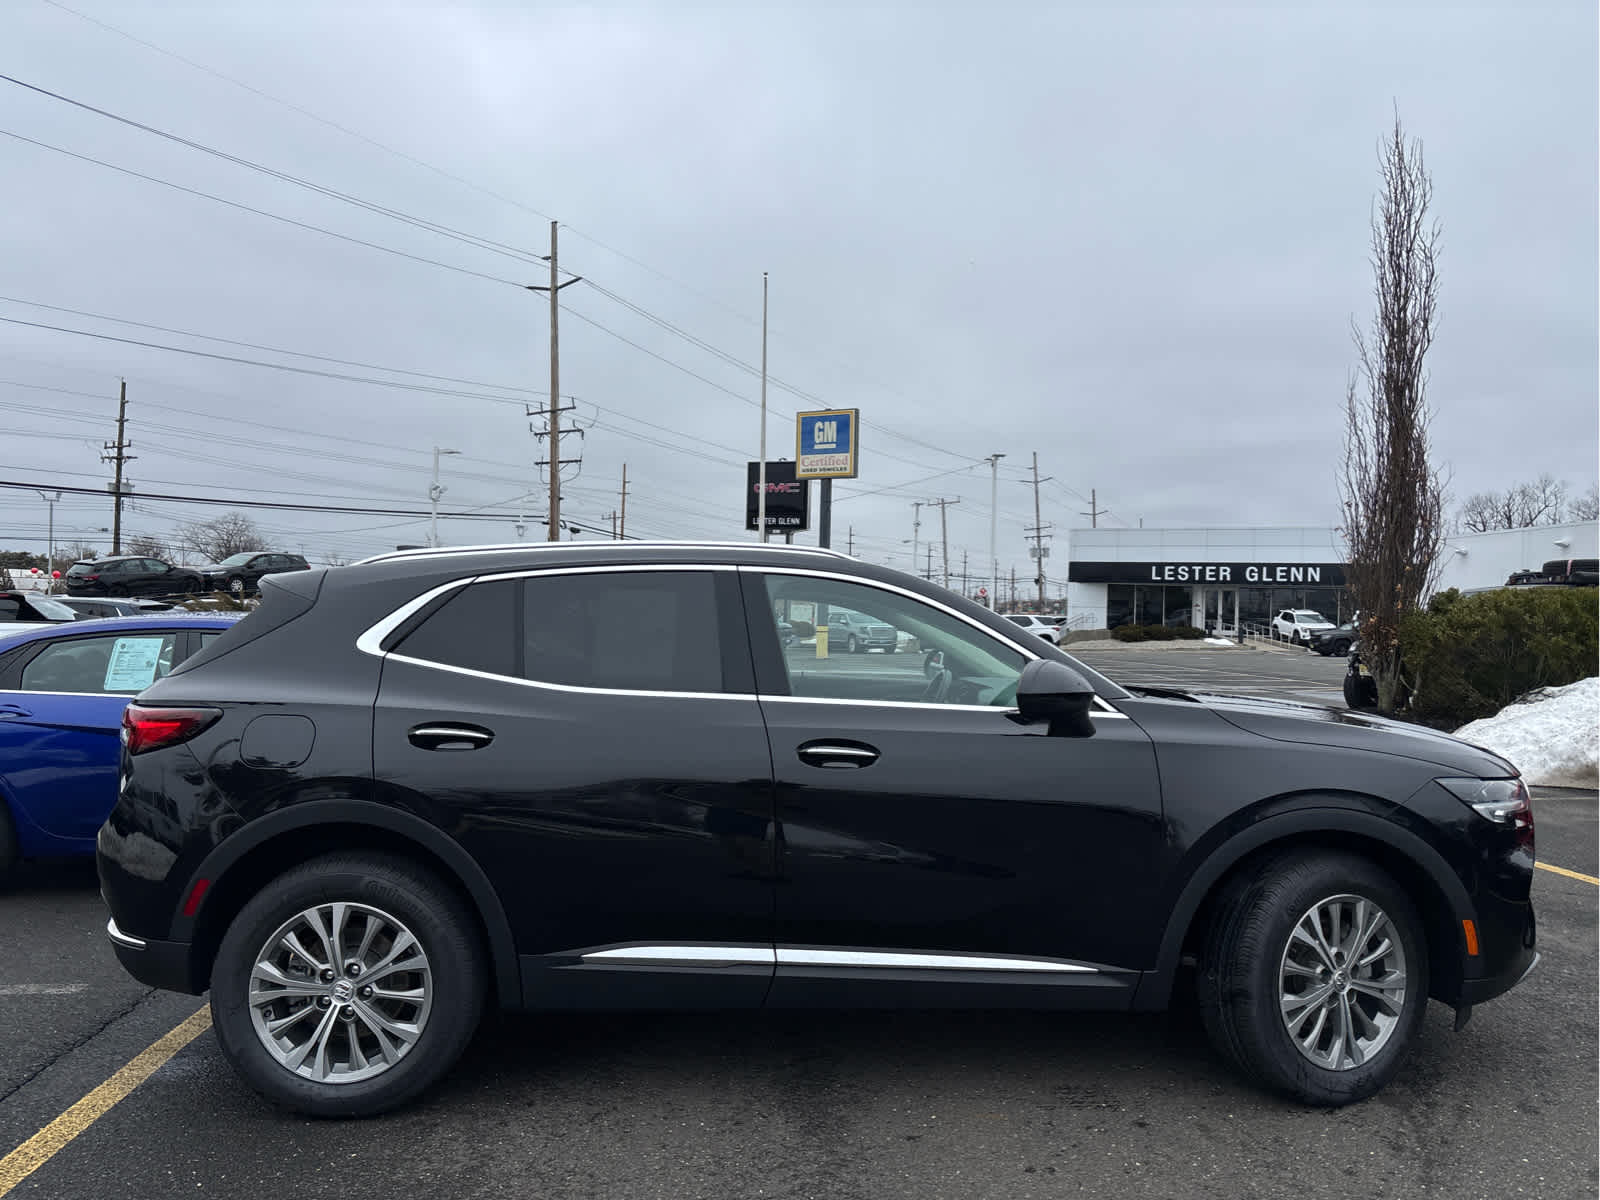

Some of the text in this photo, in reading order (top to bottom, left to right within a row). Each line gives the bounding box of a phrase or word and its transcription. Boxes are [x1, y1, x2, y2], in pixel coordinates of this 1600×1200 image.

[814, 421, 837, 443] GM
[801, 455, 849, 467] Certified
[753, 482, 801, 494] GMC
[752, 517, 801, 525] LETER GLENN
[1151, 565, 1321, 583] LESTER GLENN
